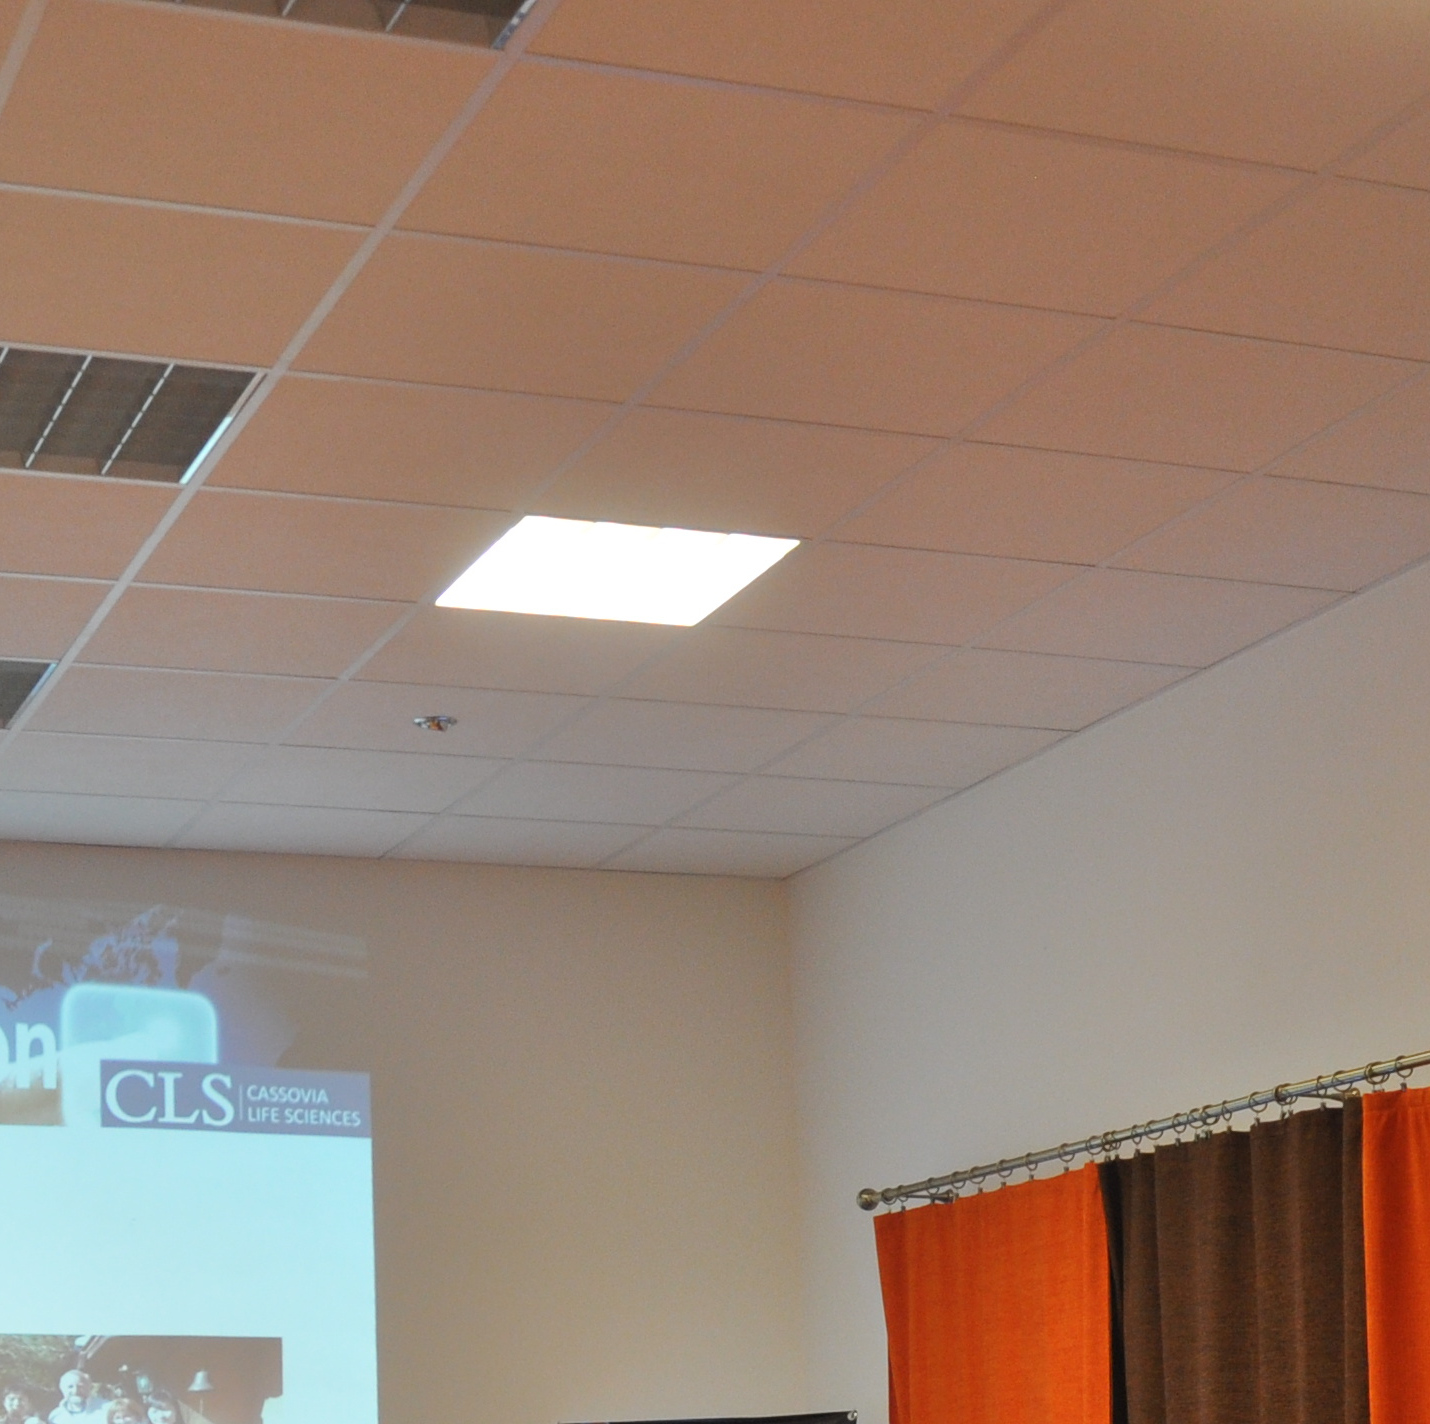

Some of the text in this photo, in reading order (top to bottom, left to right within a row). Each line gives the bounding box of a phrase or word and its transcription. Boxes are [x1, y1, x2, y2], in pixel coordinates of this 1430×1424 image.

[105, 1068, 235, 1127] CLS
[247, 1084, 329, 1104] CASSOVIA
[247, 1105, 362, 1127] LIFE SCIENCES
